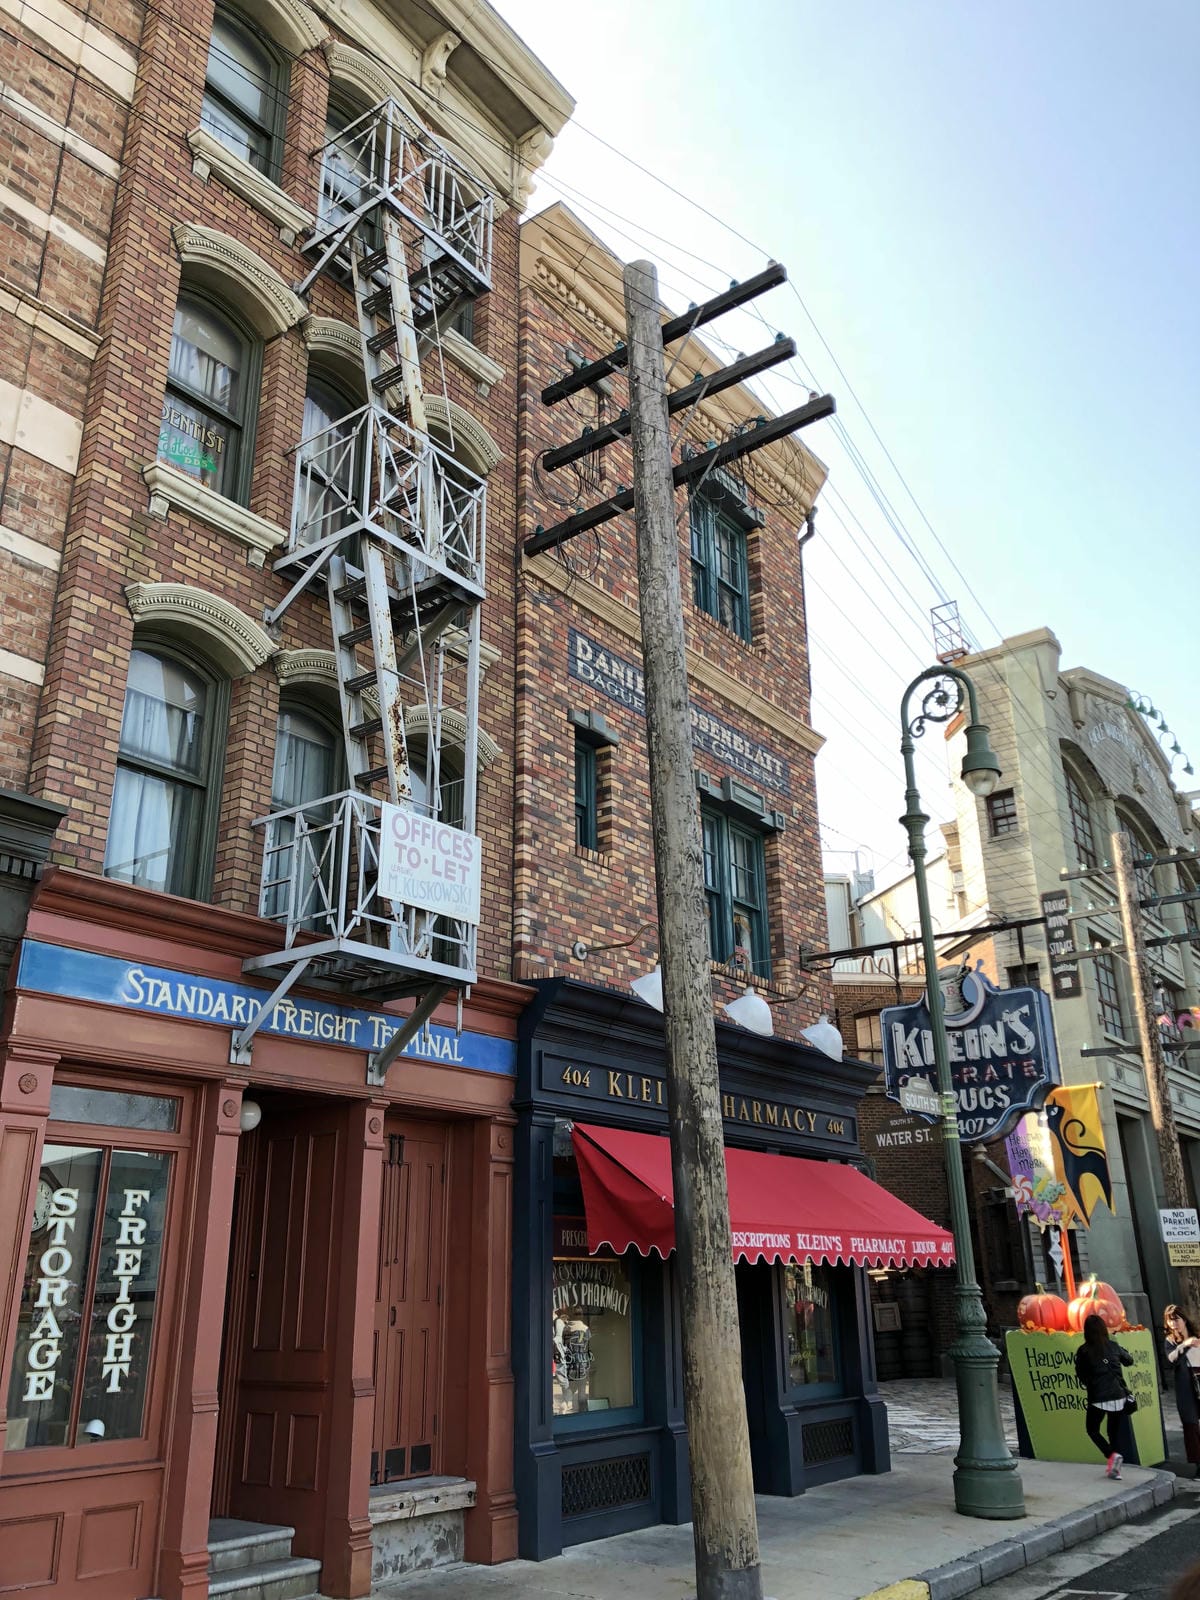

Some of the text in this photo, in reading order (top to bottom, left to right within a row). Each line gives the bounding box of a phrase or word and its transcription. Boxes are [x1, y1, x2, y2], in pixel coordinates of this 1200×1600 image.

[161, 403, 225, 454] DENTIST
[576, 635, 646, 697] DANIE
[688, 708, 783, 776] OSENBLATT
[711, 740, 783, 790] GALLERY
[392, 812, 473, 862] OFFICES
[394, 841, 420, 869] TO
[432, 855, 470, 885] LET
[121, 967, 262, 1024] STANDARD
[270, 999, 361, 1043] FREIGHT
[368, 1015, 464, 1062] TEMINAL
[562, 1066, 845, 1135] 404 KLEI HARMACY 404
[890, 1118, 907, 1126] SOUTH
[906, 1093, 930, 1110] SOUTH
[876, 1128, 934, 1147] WATER ST.
[731, 1231, 791, 1248] ESCRIPTIONS
[797, 1233, 843, 1252] KLEIN'S
[850, 1237, 906, 1254] PHARMACY
[1162, 1216, 1197, 1225] PARKING
[22, 1187, 80, 1401] STORAGE
[101, 1188, 151, 1393] FREIGHT
[553, 1282, 630, 1316] EIN'S PHARMACY
